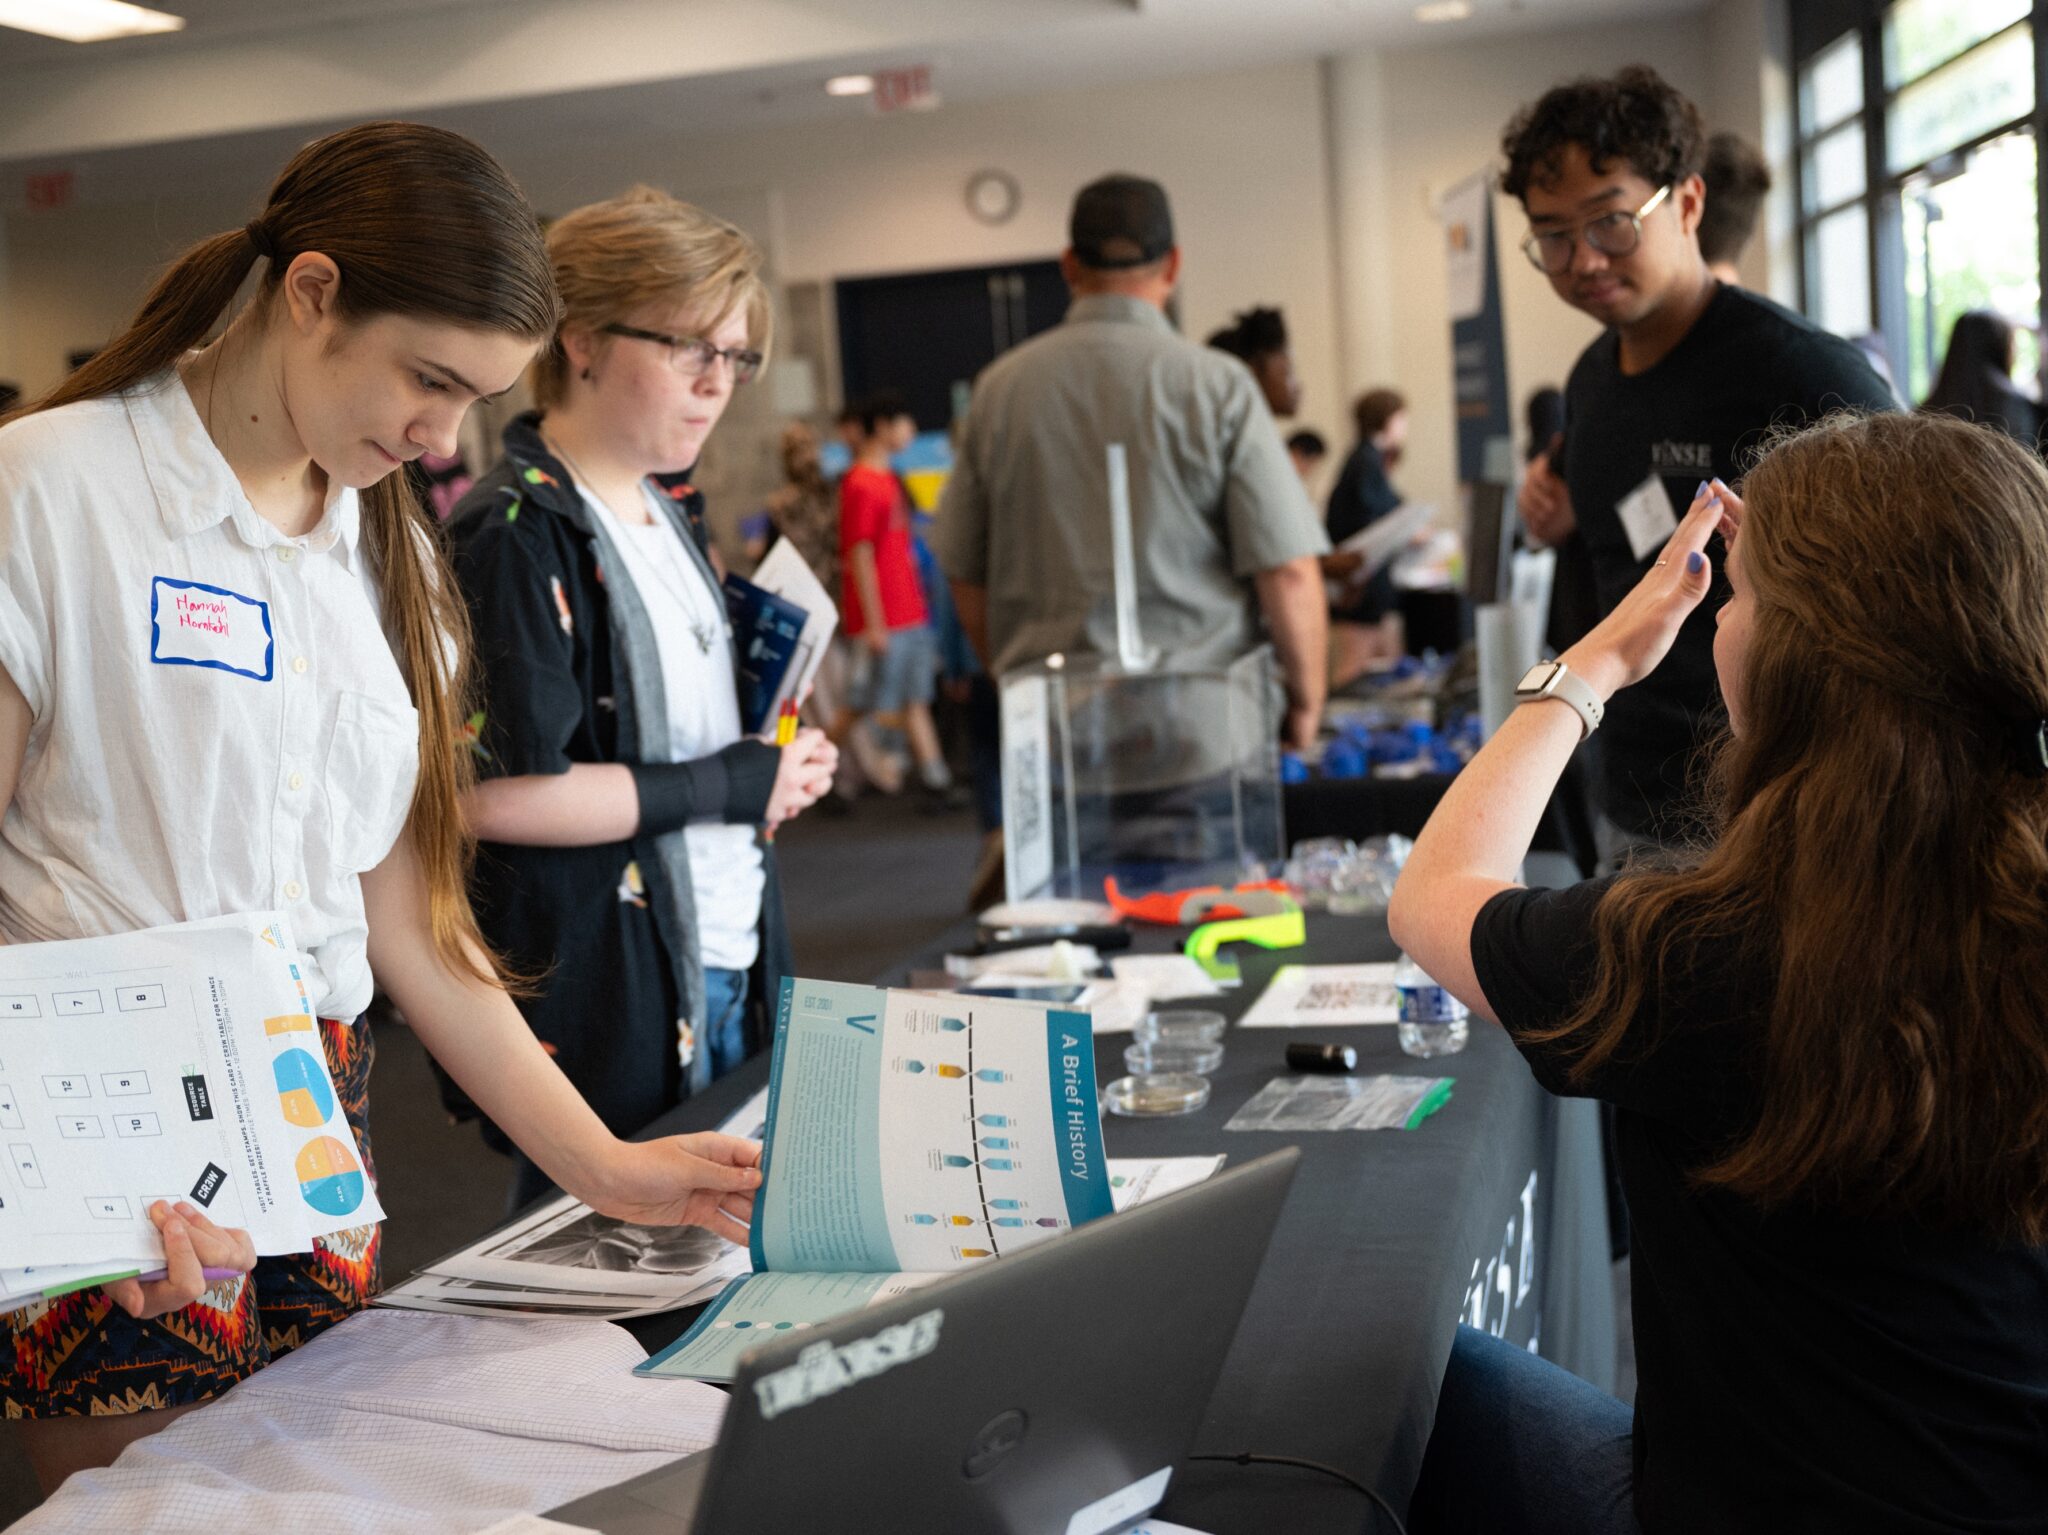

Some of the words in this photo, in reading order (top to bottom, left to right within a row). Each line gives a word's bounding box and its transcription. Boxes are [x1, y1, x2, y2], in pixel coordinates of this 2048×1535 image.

[176, 594, 228, 618] Hannah
[208, 976, 218, 1002] CHANCE
[216, 1017, 226, 1037] TABLE
[846, 1014, 876, 1034] V
[1062, 1034, 1079, 1049] A
[62, 1080, 72, 1092] 12
[227, 1068, 237, 1086] CARD
[1063, 1055, 1084, 1107] Brief
[187, 1082, 201, 1117] RESOURCE
[198, 1087, 208, 1109] TABLE
[232, 1088, 240, 1103] THIS
[236, 1105, 245, 1123] SHOW
[76, 1122, 86, 1132] 11
[131, 1119, 142, 1131] 10
[1067, 1111, 1089, 1180] History
[247, 1155, 255, 1167] GET
[261, 1171, 271, 1196] RAFFLE
[258, 1196, 267, 1213] VISIT
